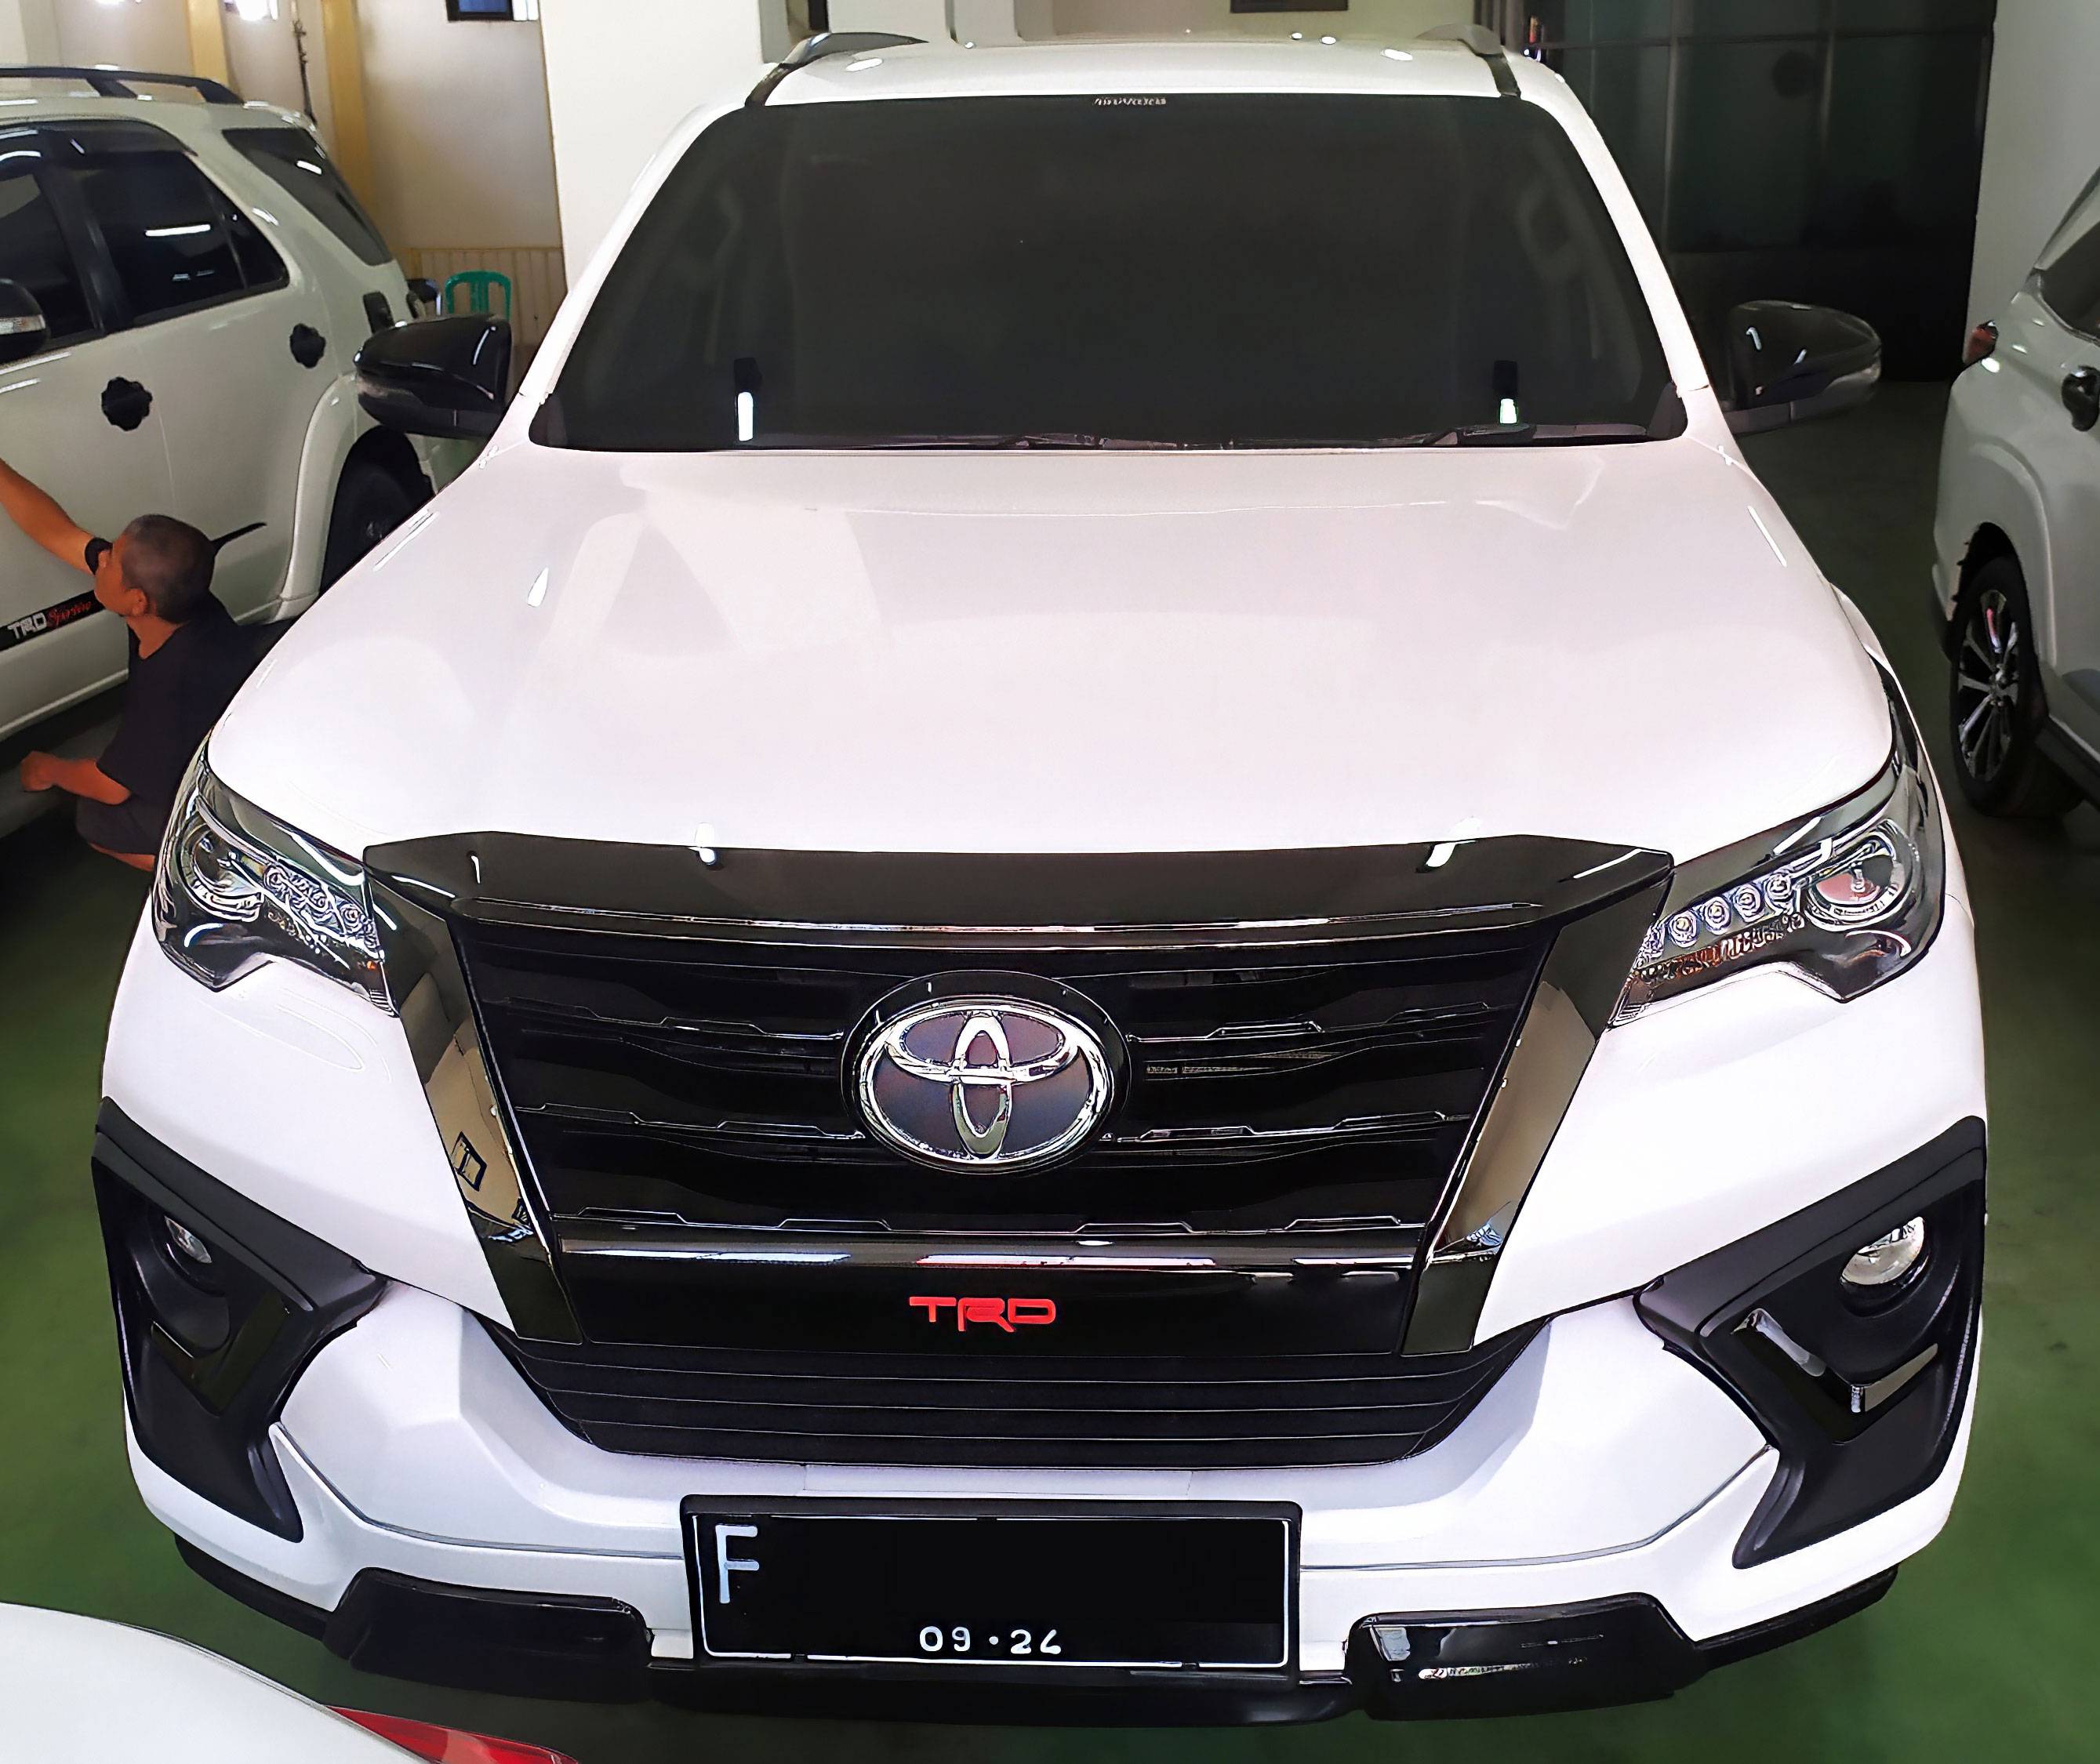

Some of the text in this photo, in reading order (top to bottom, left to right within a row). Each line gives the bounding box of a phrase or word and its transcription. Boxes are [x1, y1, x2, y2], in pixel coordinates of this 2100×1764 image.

[7, 612, 47, 639] TRD
[909, 1296, 1056, 1332] TRD
[714, 1523, 760, 1604] F
